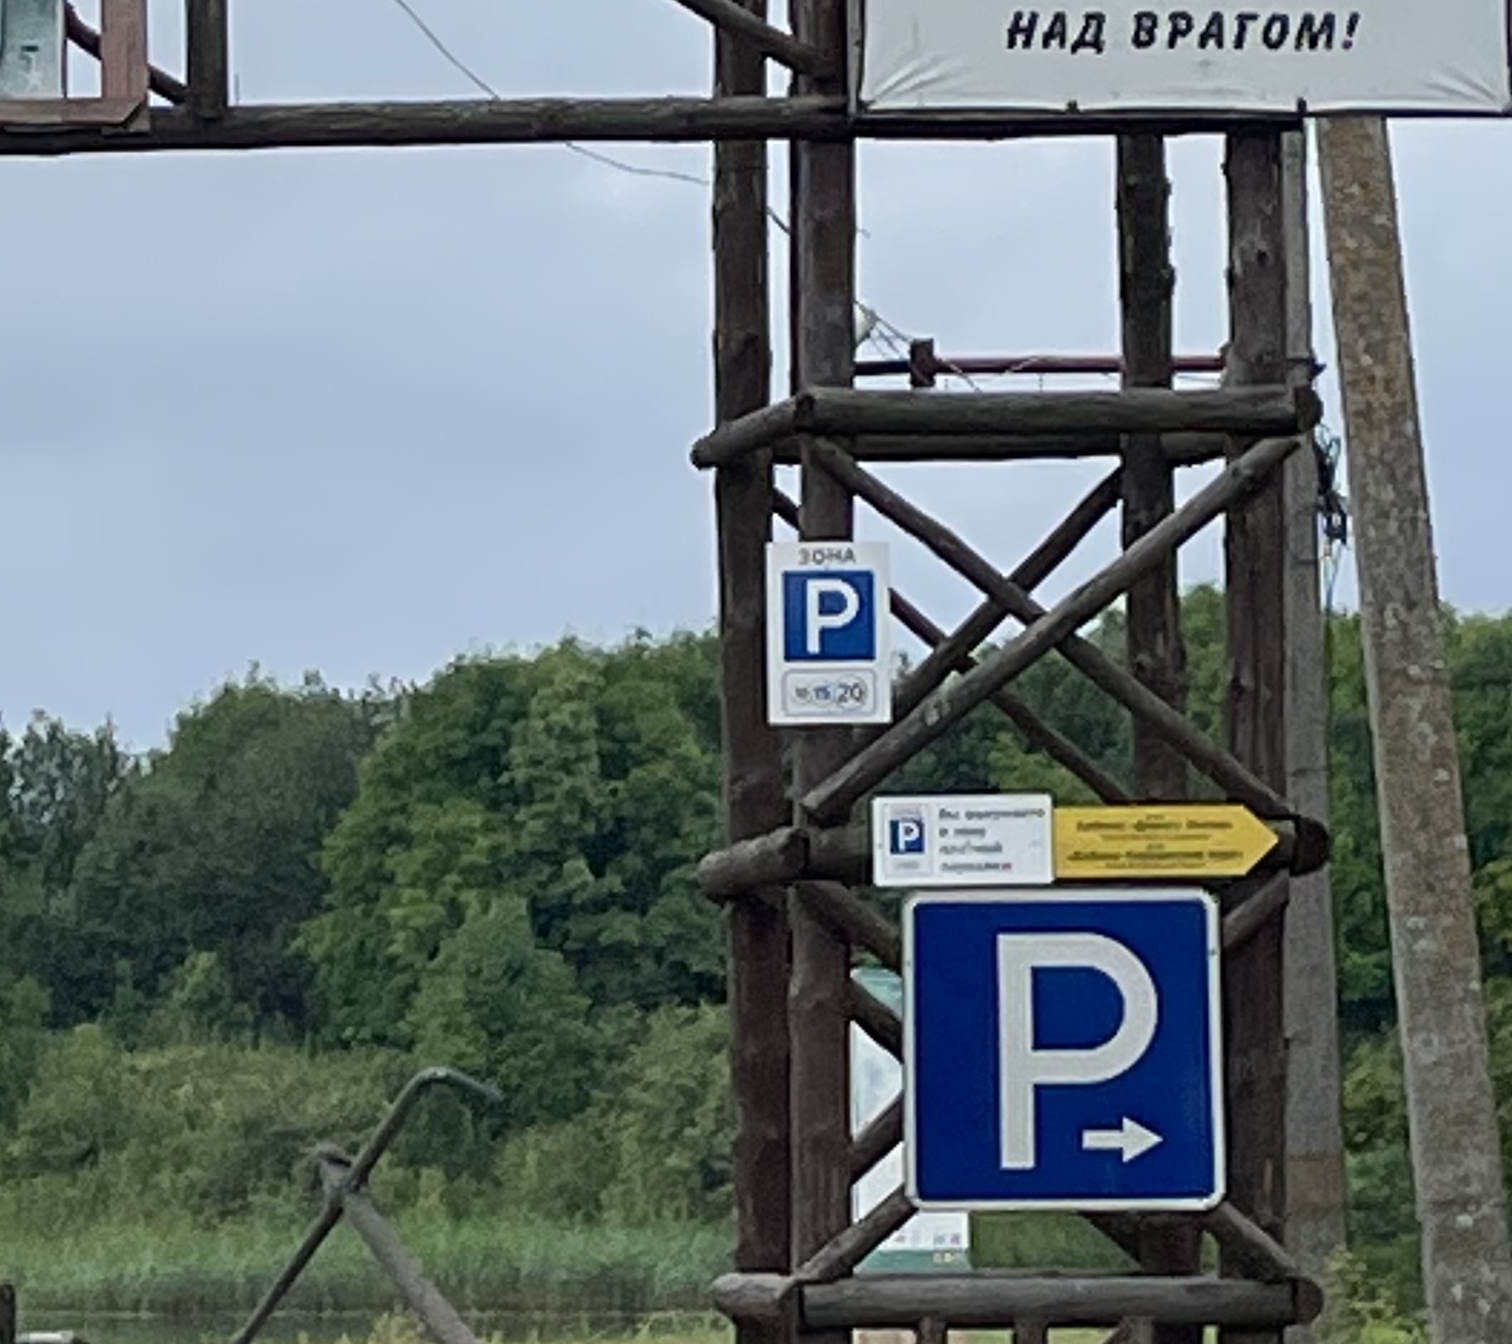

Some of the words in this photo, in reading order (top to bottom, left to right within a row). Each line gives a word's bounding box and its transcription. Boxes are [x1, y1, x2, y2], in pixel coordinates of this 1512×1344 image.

[1006, 10, 1107, 56] НАД
[1130, 10, 1361, 52] ВРАГОМ!
[798, 547, 857, 566] ЗОНА
[806, 578, 860, 655] P
[838, 682, 864, 703] 20
[996, 932, 1159, 1170] P
